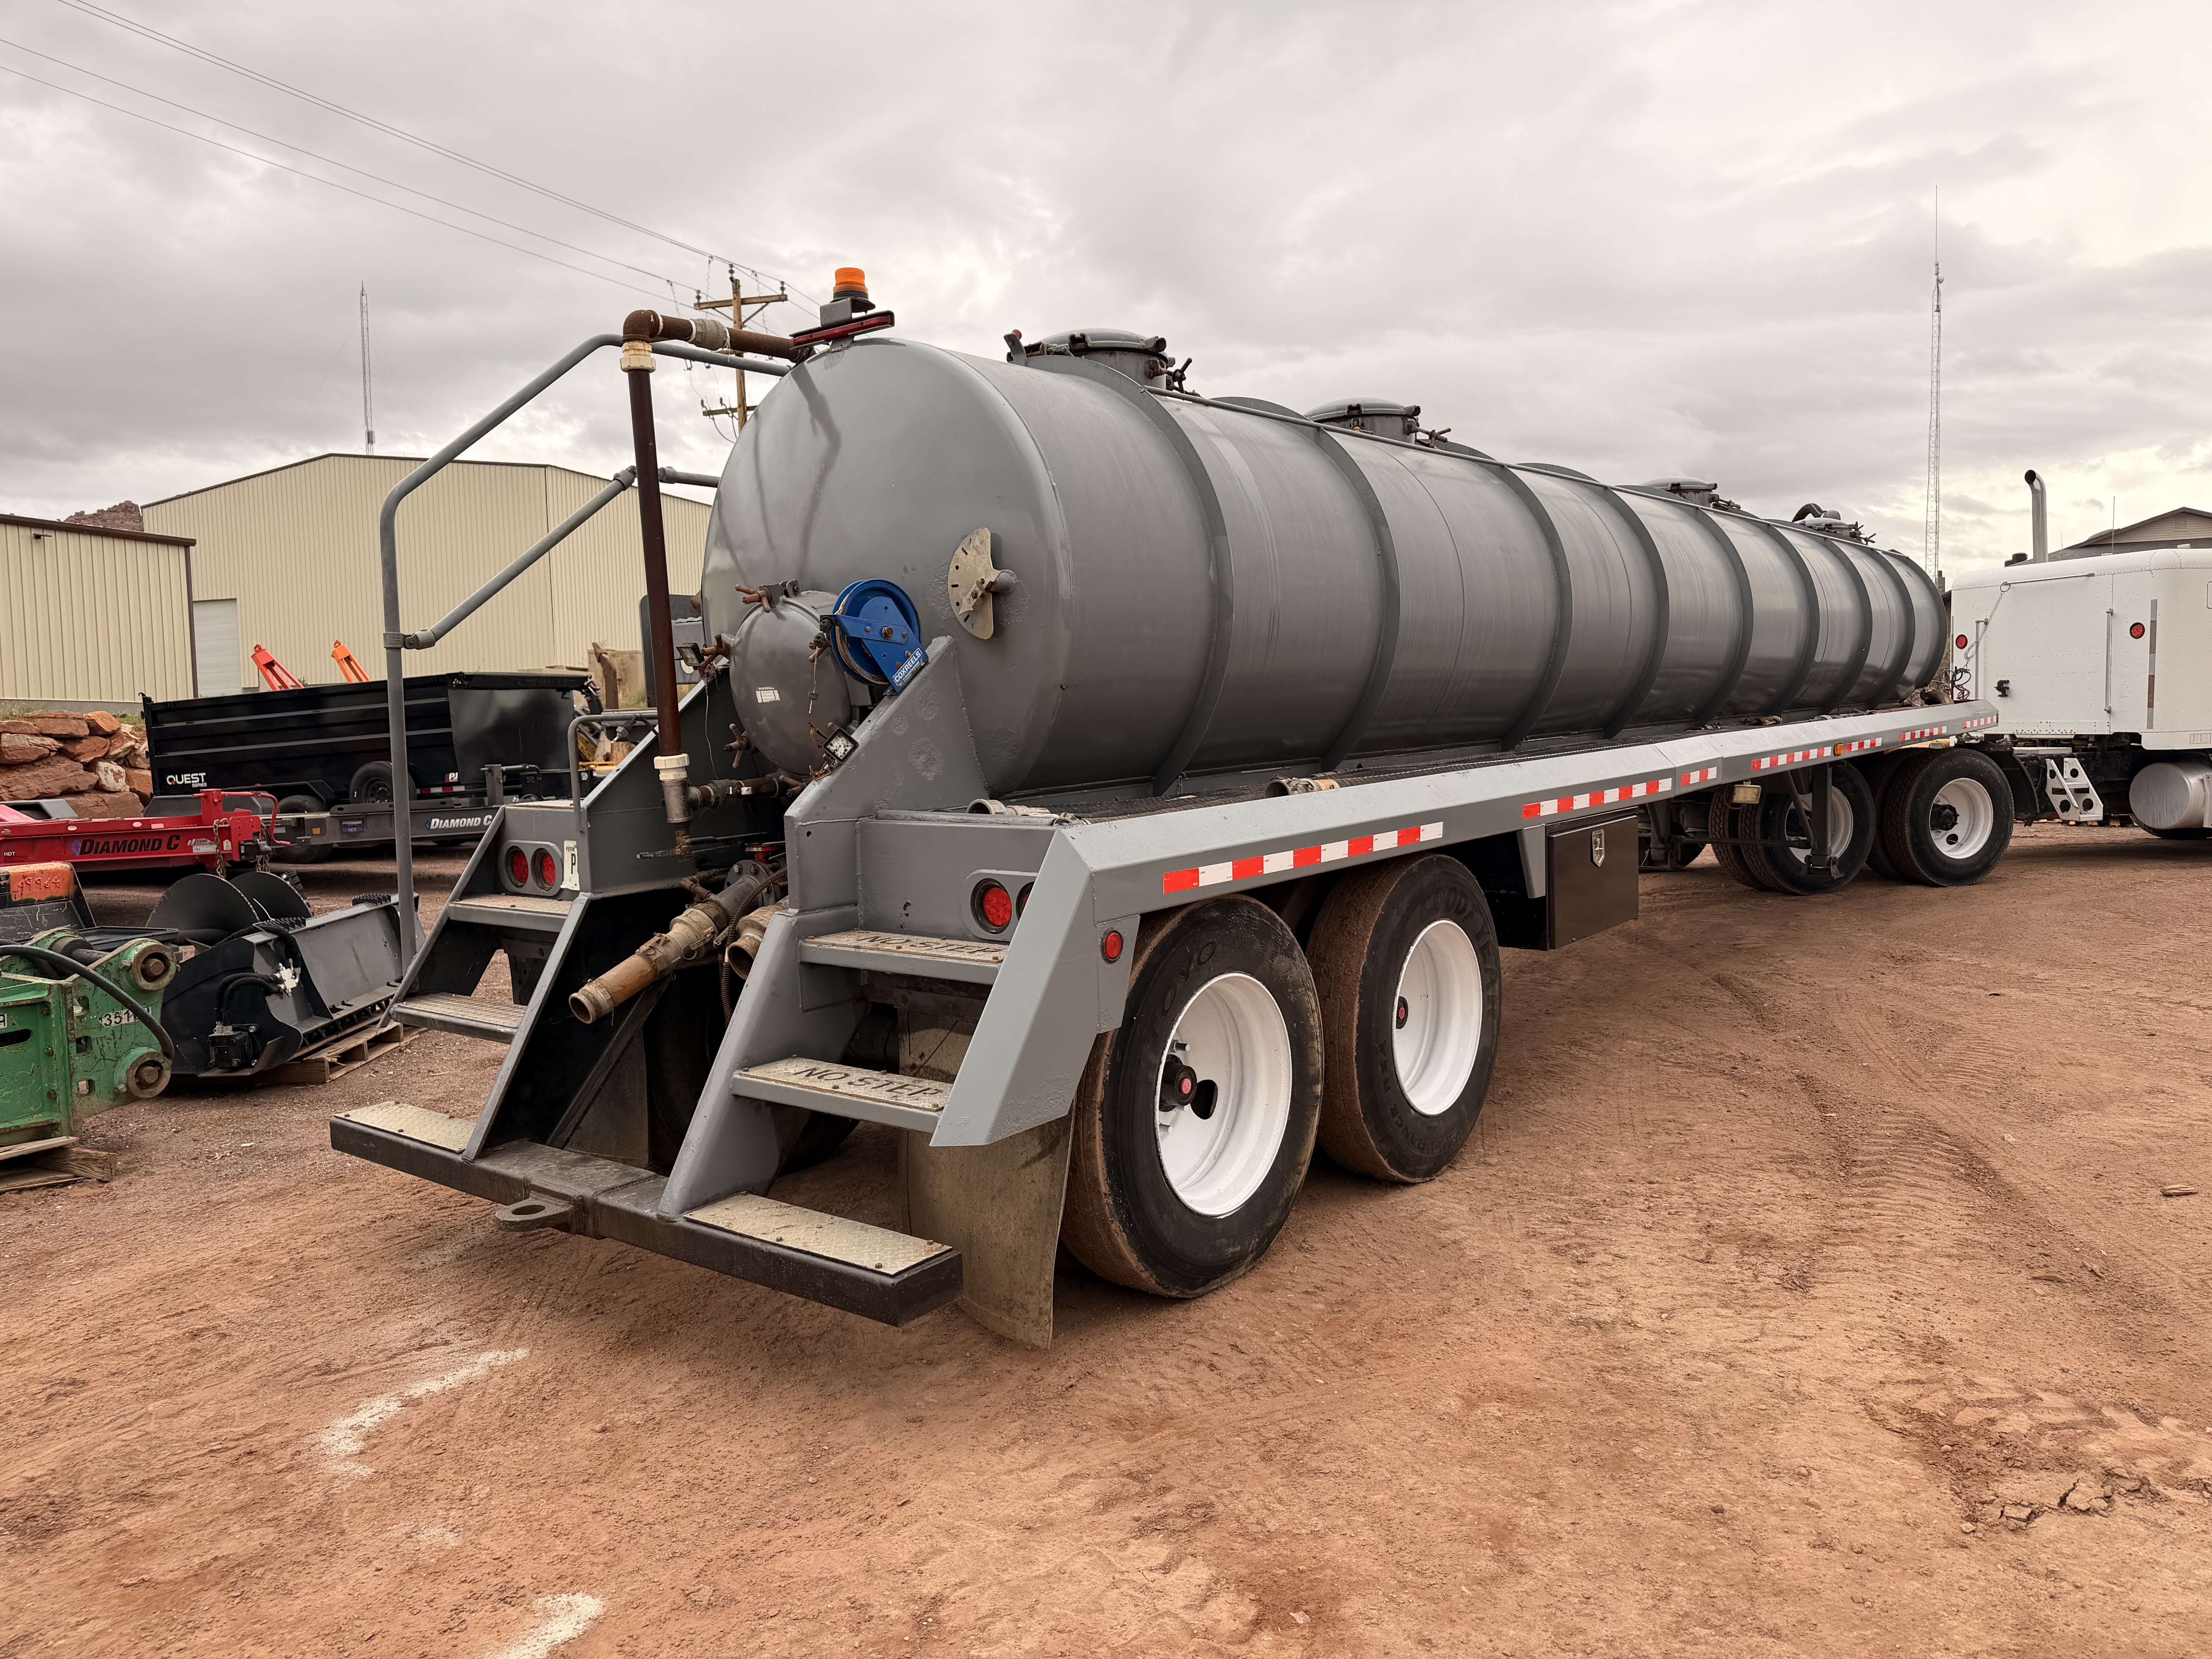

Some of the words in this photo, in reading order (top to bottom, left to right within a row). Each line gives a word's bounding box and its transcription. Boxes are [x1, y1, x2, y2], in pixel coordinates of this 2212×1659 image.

[894, 651, 921, 683] COXREELS
[166, 773, 206, 785] QUEST
[449, 772, 459, 780] PJ
[430, 817, 481, 830] DIAMOND
[483, 814, 493, 826] C
[79, 838, 163, 855] DIAMOND
[166, 834, 180, 850] C
[571, 853, 576, 874] P
[856, 936, 912, 944] NO
[909, 941, 1003, 953] STEP
[1144, 939, 1217, 1050] TOYO
[792, 1067, 851, 1081] NO
[847, 1077, 944, 1096] STEP
